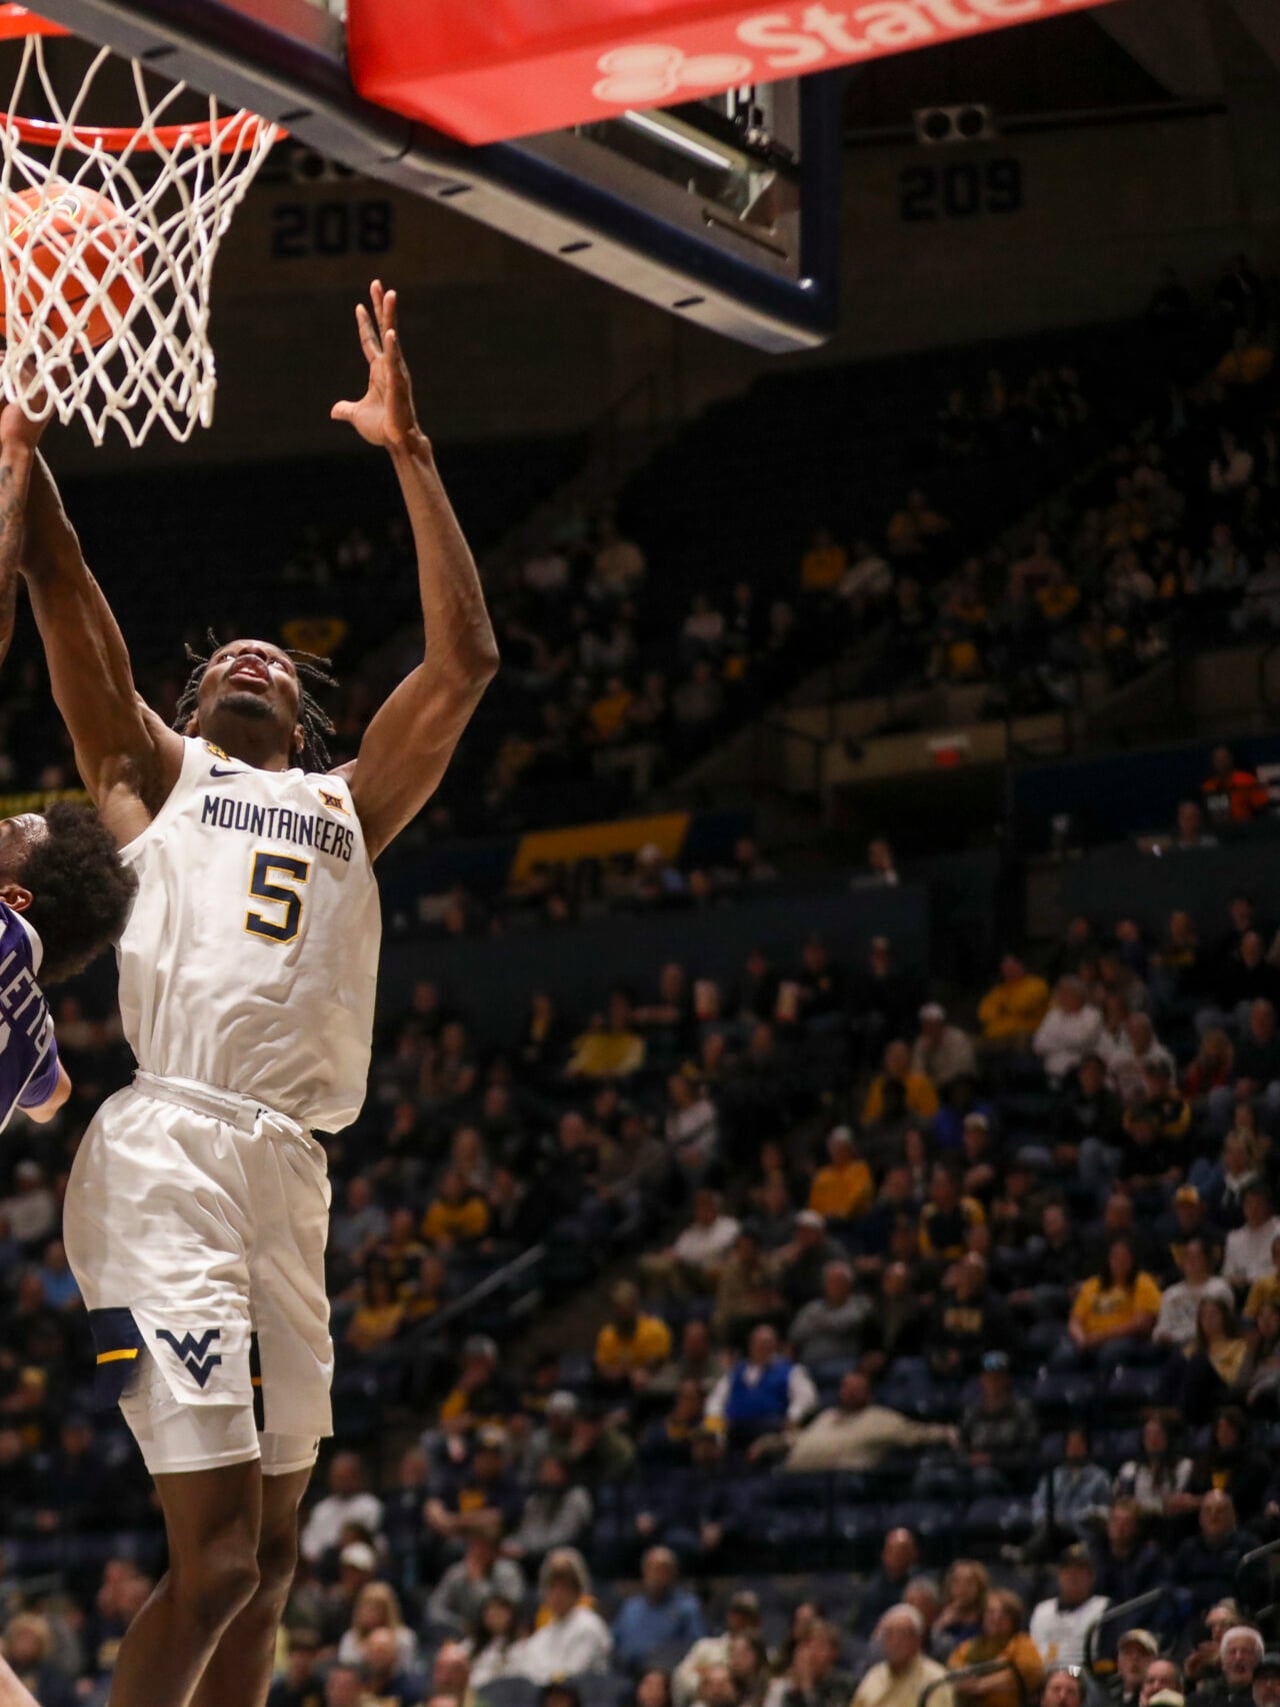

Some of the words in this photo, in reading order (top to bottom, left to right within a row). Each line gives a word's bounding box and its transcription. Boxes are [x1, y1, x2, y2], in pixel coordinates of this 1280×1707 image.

[899, 159, 1022, 220] 209
[273, 201, 392, 257] 208
[201, 795, 354, 863] MOUNTAINEERS
[244, 851, 311, 944] 5
